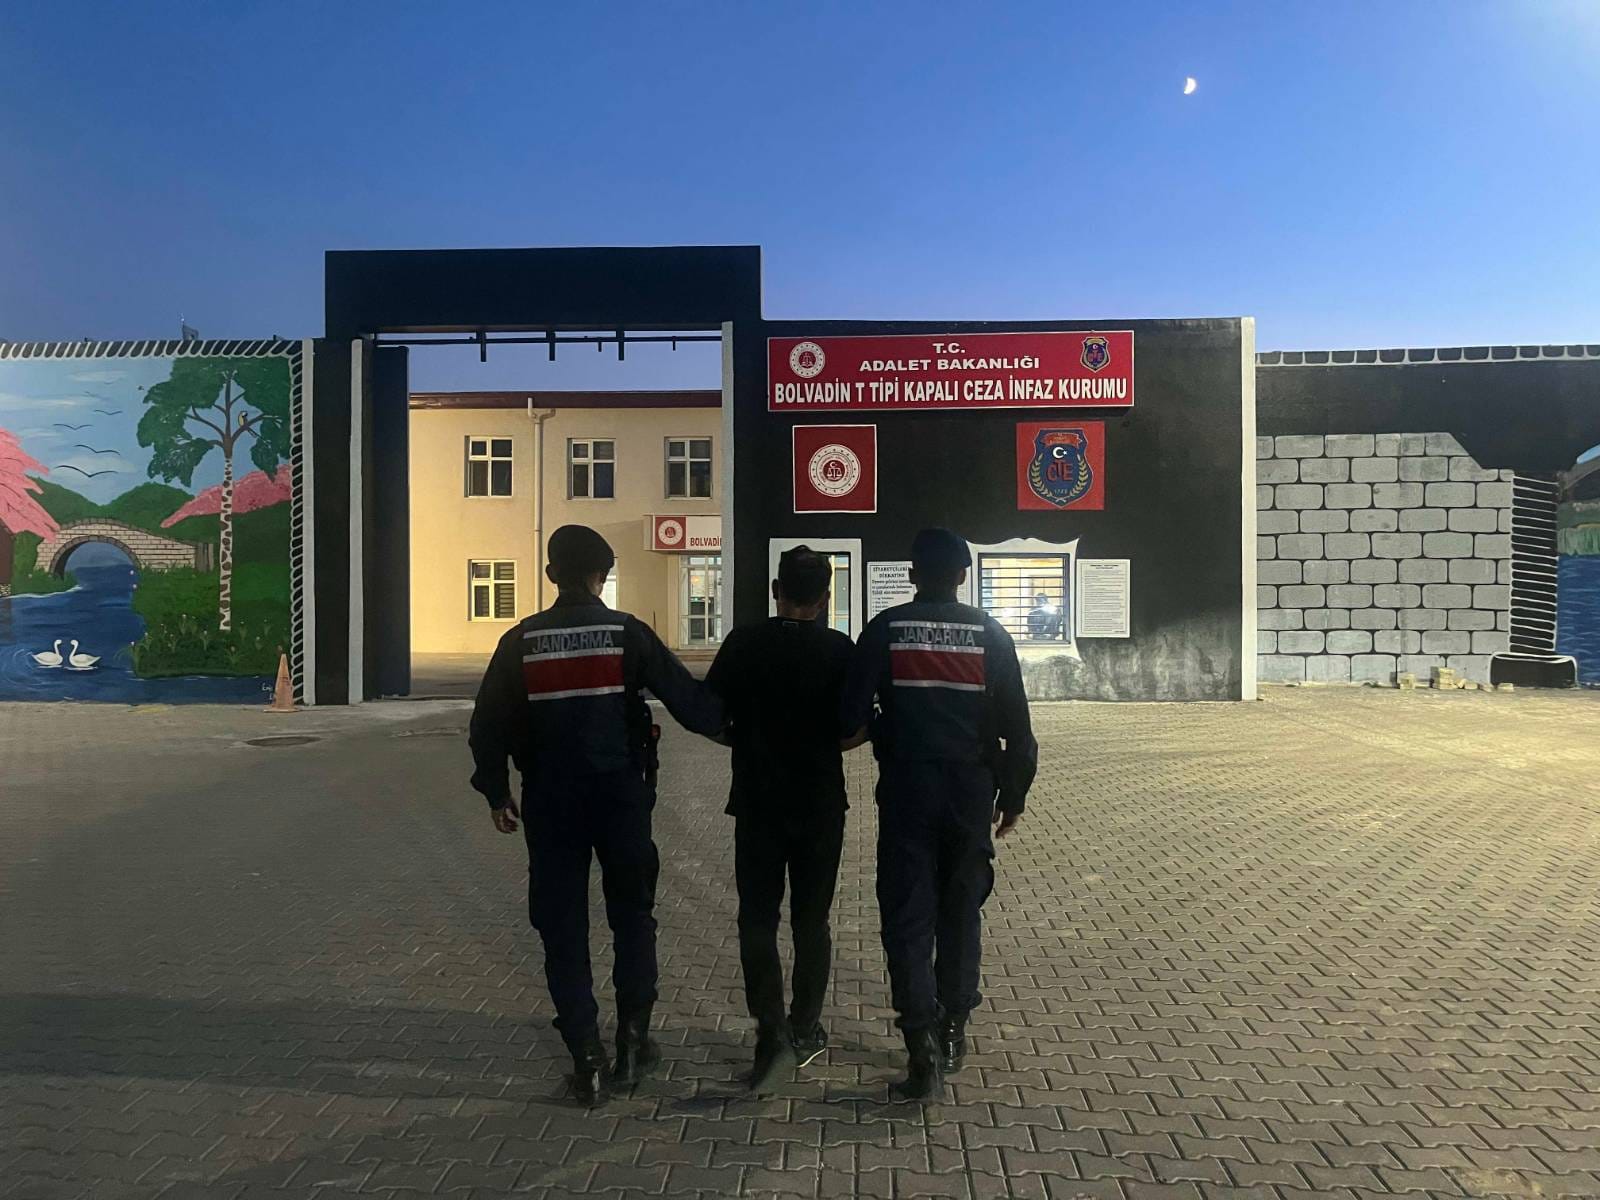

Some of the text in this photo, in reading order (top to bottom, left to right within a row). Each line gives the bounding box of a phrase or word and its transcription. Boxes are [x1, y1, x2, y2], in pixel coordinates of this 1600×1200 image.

[932, 342, 966, 354] T.C.
[859, 355, 1040, 372] ADALET BAKANLIĞI
[774, 374, 1127, 404] BOLVADİN T TİPİ KAPALI CEZA İNFAZ KURUMU
[532, 631, 614, 653] JANDARMA
[899, 626, 976, 647] JANDARMA
